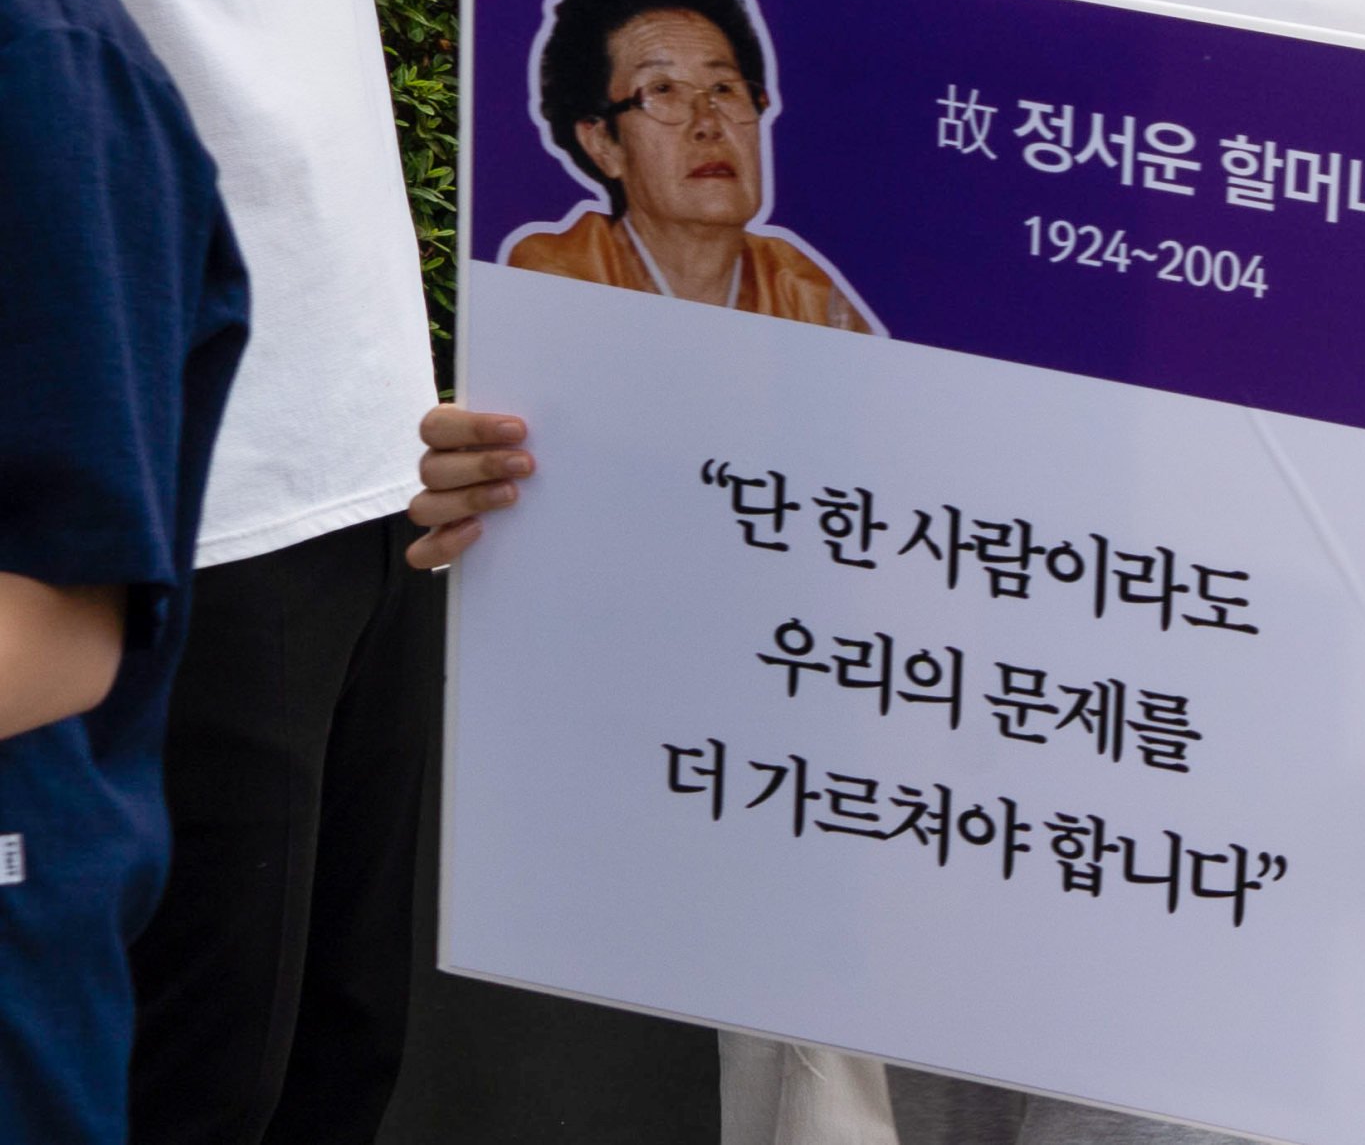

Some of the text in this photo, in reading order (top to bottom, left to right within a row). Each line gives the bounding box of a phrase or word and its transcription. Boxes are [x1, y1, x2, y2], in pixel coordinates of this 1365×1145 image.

[936, 84, 998, 159] 故
[1013, 99, 1202, 196] 정서운
[1024, 216, 1269, 298] 1924~2004
[812, 484, 887, 571] 한
[898, 503, 1259, 636] 사람이라도
[757, 617, 1203, 774] 우리의 문제를
[661, 738, 725, 823] 더
[745, 754, 1032, 878] 가르쳐야
